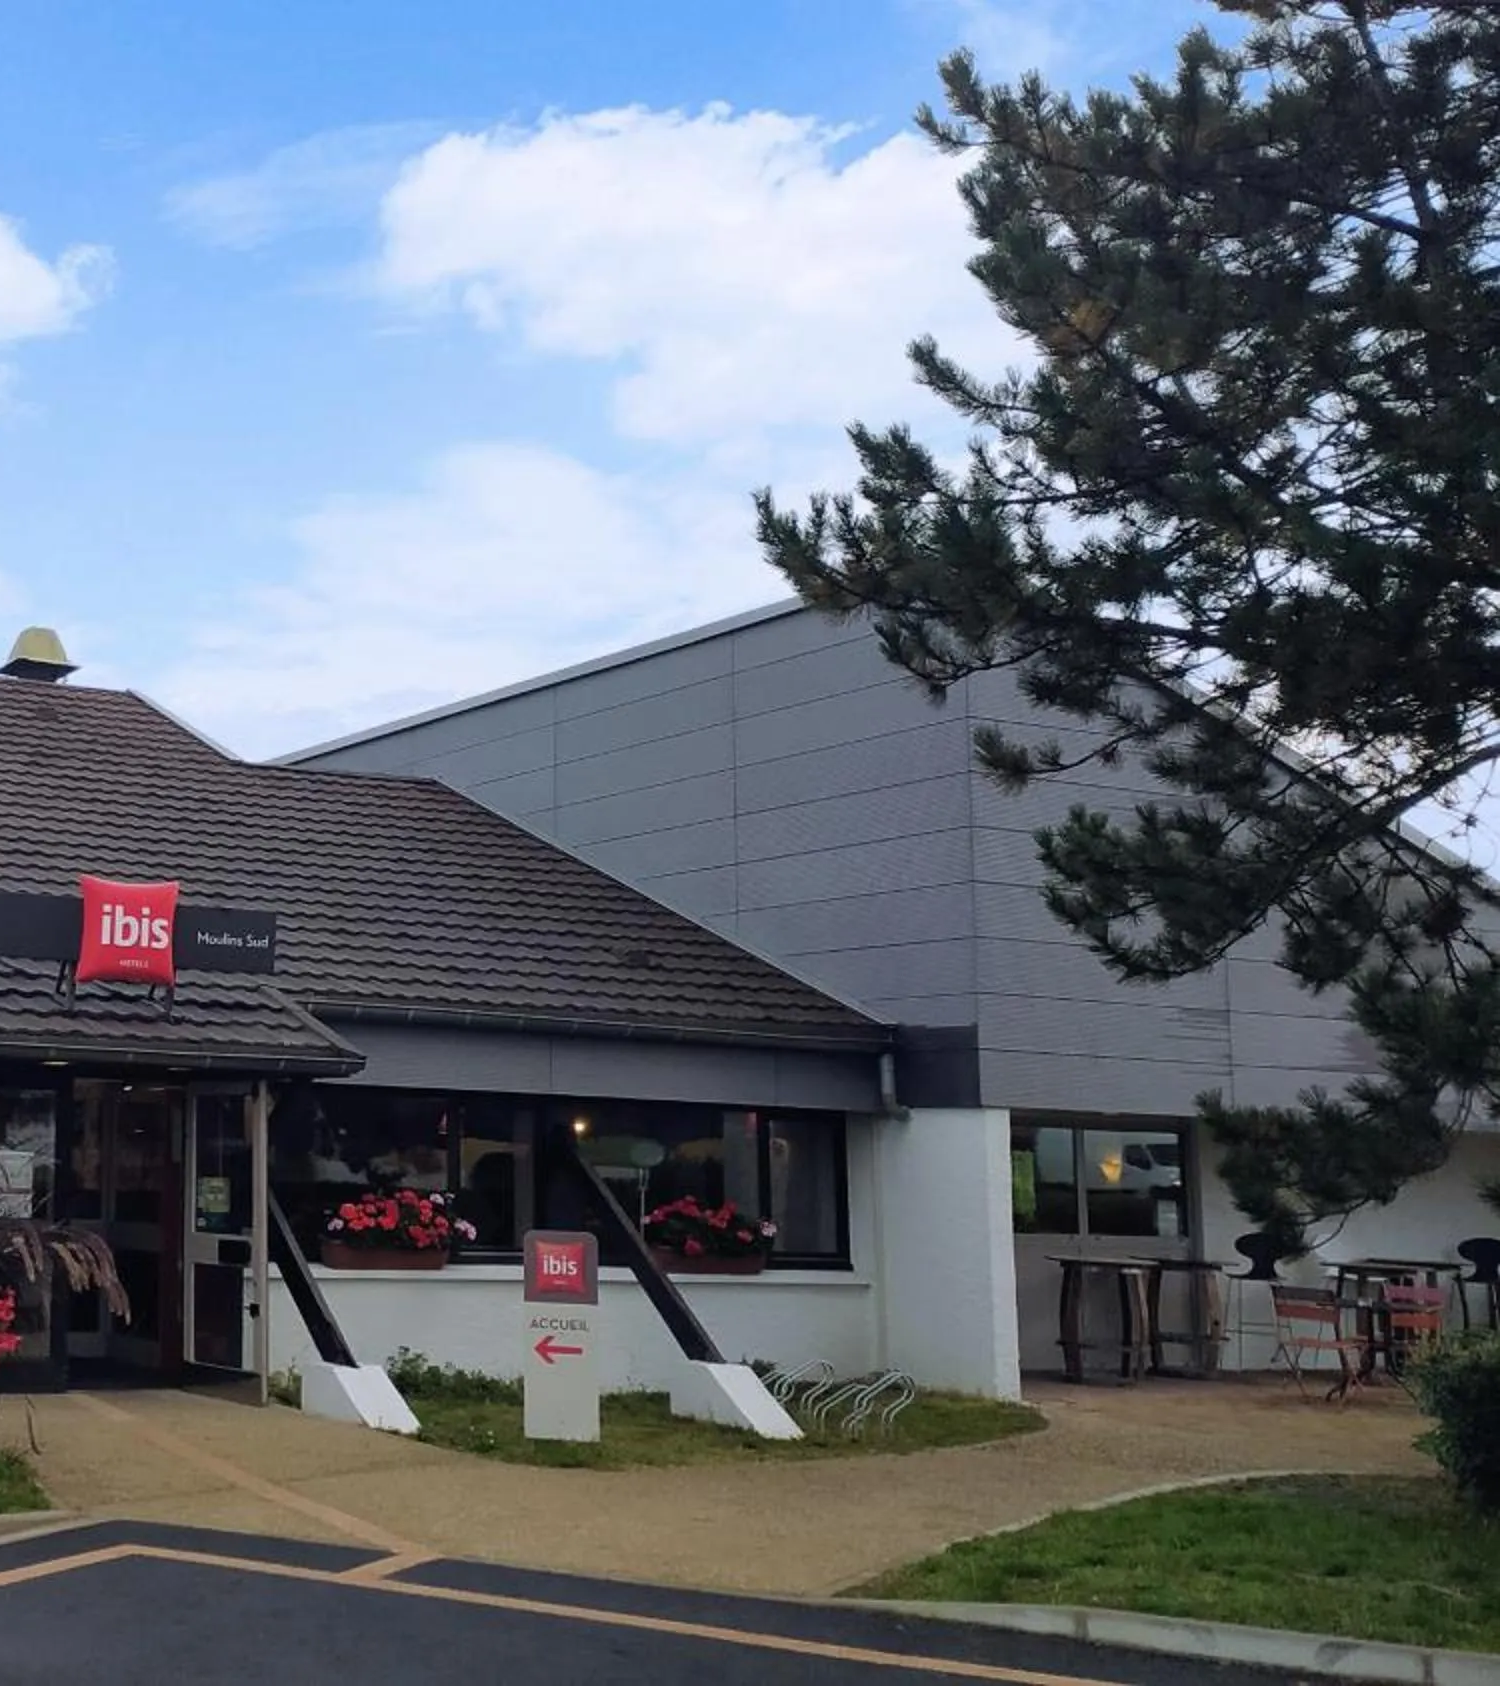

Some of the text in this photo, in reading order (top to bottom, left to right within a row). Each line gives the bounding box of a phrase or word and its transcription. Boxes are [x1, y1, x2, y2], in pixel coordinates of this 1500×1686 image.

[101, 904, 169, 949] ibis
[197, 931, 269, 948] Moulins Sud
[543, 1255, 577, 1276] ibis
[530, 1318, 588, 1331] ACCUEIL
